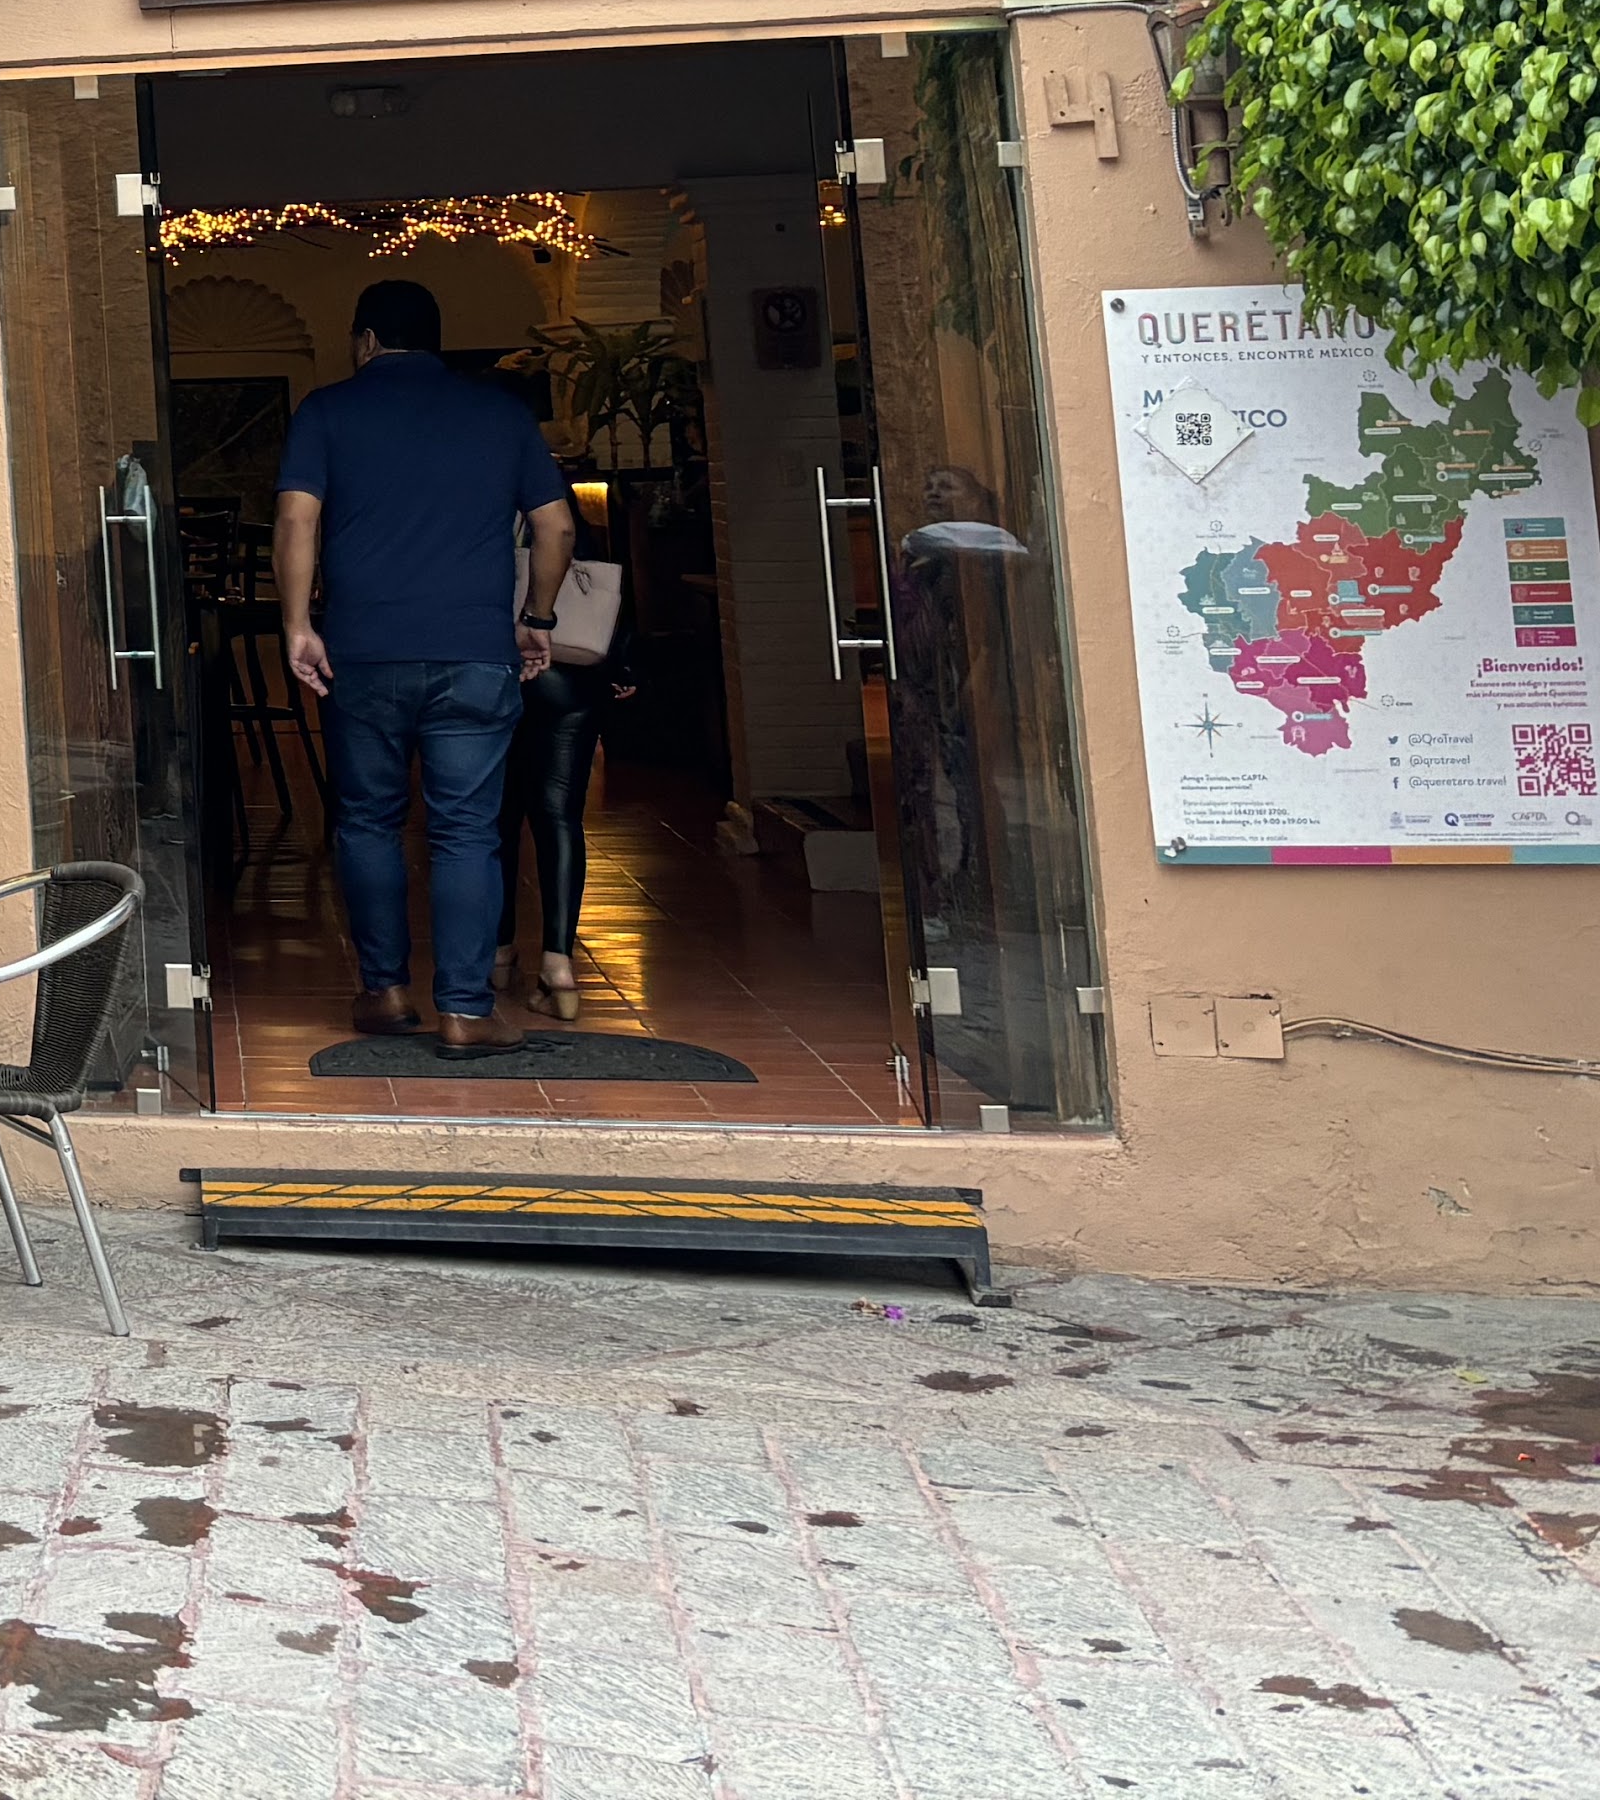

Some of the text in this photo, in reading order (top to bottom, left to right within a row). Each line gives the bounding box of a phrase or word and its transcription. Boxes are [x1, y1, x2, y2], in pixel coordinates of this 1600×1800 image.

[1141, 354, 1150, 364] Y
[1154, 353, 1232, 363] ENTONCES,
[1238, 348, 1314, 360] ENCONTRÉ
[1476, 657, 1584, 678] ¡Bienvenidos!
[1408, 733, 1474, 747] @QroTravel
[1409, 755, 1470, 769] @qrotravel
[1241, 773, 1268, 782] CAPTA
